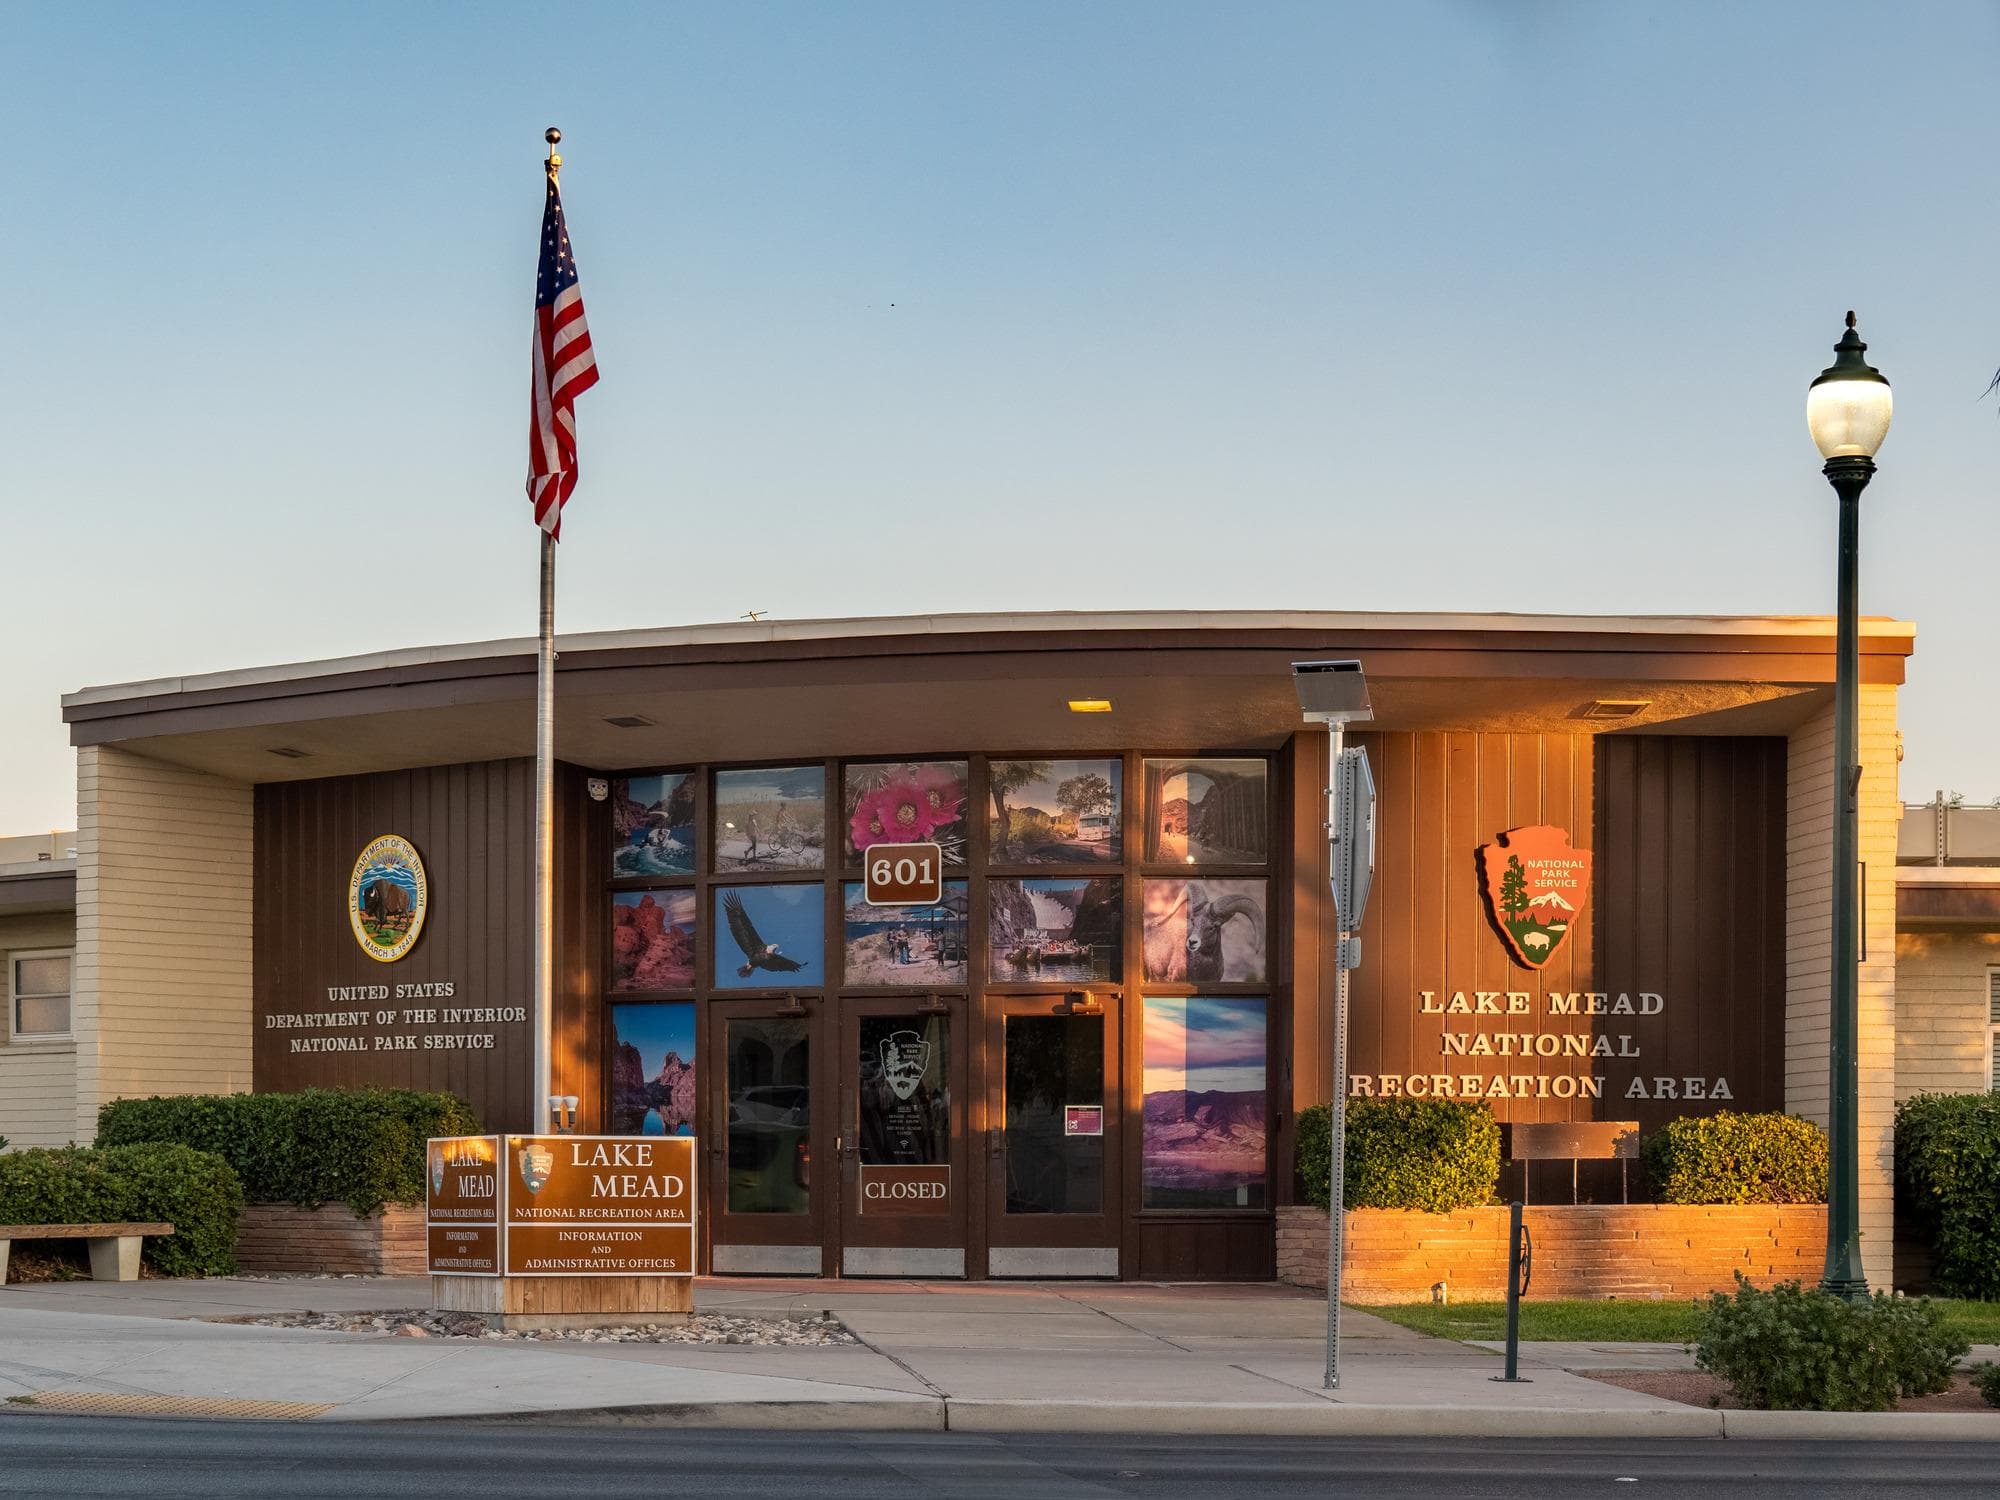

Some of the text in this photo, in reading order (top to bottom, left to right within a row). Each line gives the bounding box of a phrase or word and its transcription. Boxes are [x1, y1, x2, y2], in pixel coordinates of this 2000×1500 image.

[353, 839, 389, 887] DEPARTMENT
[390, 839, 402, 849] OF
[402, 844, 414, 859] THE
[413, 859, 424, 907] INTERIOR
[871, 857, 935, 887] 601
[1527, 859, 1585, 869] NATIONAL
[1541, 869, 1571, 878] PARK
[1534, 879, 1578, 888] SERVICE
[363, 939, 388, 958] MARCH
[398, 933, 414, 953] 1849
[327, 982, 455, 1001] UNITED STATES
[1420, 990, 1665, 1016] LAKE MEAD
[265, 1007, 527, 1029] DEPARTMENT OF THE INTERIOR
[290, 1034, 494, 1053] NATIONAL PARK SERVICE
[1441, 1032, 1641, 1058] NATIONAL
[1348, 1074, 1735, 1100] RECREATION AREA
[451, 1143, 483, 1167] LAKE
[571, 1143, 654, 1167] LAKE
[458, 1175, 495, 1198] MEAD
[591, 1174, 684, 1198] MEAD
[864, 1181, 947, 1200] CLOSED
[430, 1208, 495, 1218] NATIONAL RECREATION AREA
[515, 1207, 685, 1218] NATIONAL RECREATION AREA
[446, 1231, 479, 1241] INFORMATION
[559, 1231, 643, 1241] INFORMATION
[591, 1246, 612, 1254] AND
[434, 1258, 492, 1268] ADMINISTRATIVE OFFICES
[525, 1258, 676, 1268] ADMINISTRATIVE OFFICES
